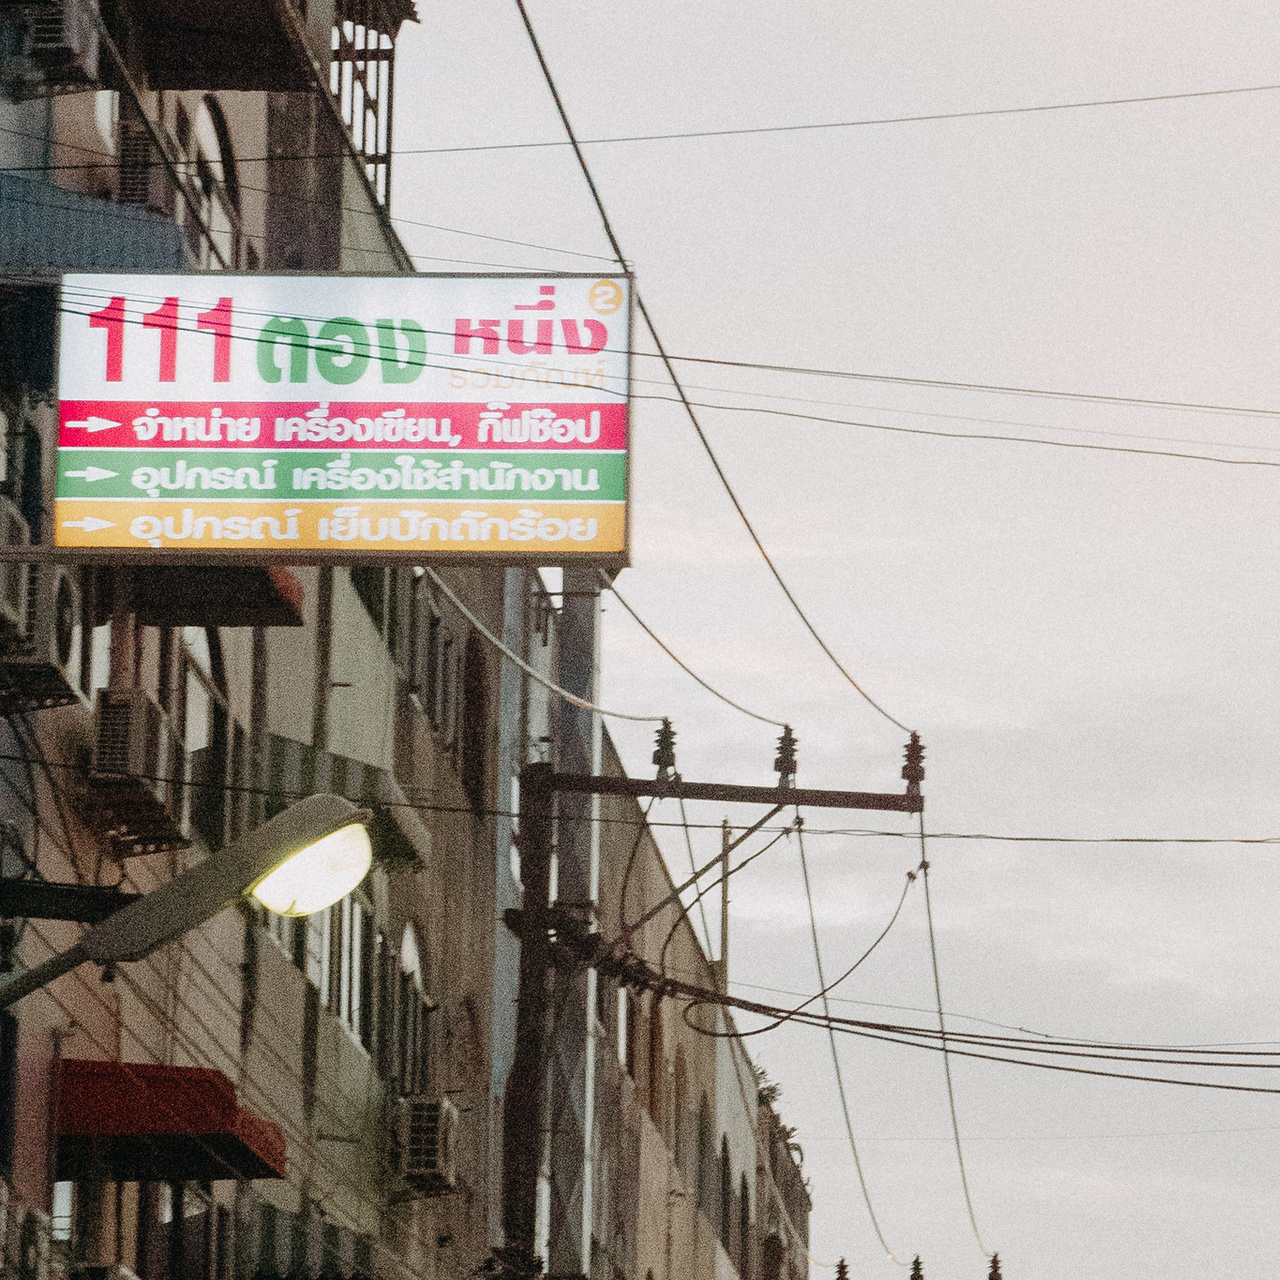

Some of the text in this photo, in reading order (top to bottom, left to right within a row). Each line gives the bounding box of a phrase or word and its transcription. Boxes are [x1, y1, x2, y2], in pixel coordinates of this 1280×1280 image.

[89, 286, 608, 385] 111 ตอง หนึ่ง
[132, 407, 261, 442] จำหน่าย
[274, 402, 463, 447] เครื่องเขียน,
[131, 454, 599, 497] อุปกรณ์ เครื่องใช้สำนักงาน
[129, 505, 599, 548] อุปกรณ์ เย็บปักถักร้อย
